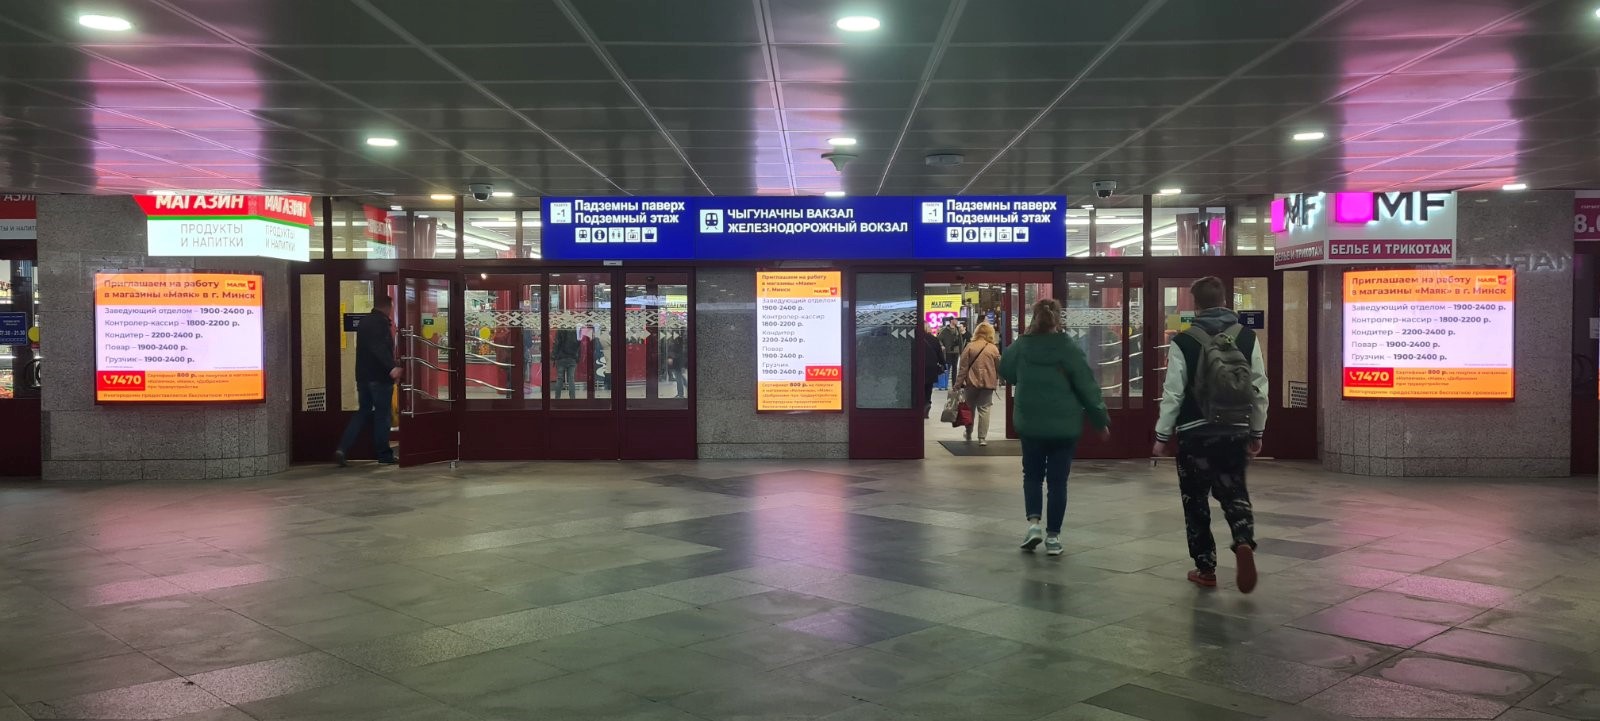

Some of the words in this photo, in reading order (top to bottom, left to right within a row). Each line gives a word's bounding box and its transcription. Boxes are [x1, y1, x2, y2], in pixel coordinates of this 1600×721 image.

[265, 196, 306, 217] МАГАЗИН
[575, 200, 638, 212] Падземны
[642, 202, 685, 212] паверх
[947, 199, 1010, 212] Падземны
[1014, 202, 1057, 212] паверх
[1374, 191, 1451, 221] MF
[557, 209, 566, 217] -1
[728, 209, 803, 219] ЧЫГУНАЧНЫ
[807, 209, 854, 219] ВАКЗАЛ
[929, 208, 937, 217] -1
[575, 212, 647, 225] Подземный
[650, 214, 679, 224] этаж
[947, 212, 1018, 225] Подземный
[1022, 214, 1051, 224] этаж
[181, 224, 243, 235] ПРОДУКТЫ
[728, 221, 856, 233] ЖЕЛЕЗНОДОРОЖНЫЙ
[860, 222, 908, 232] ВОКЗАЛ
[266, 225, 296, 240] ПРОДУКТЫ
[181, 237, 188, 247] И
[193, 237, 244, 247] НАПИТКИ
[271, 239, 296, 252] НАПИТКИ
[1331, 244, 1369, 255] БЕЛЬЕ
[1373, 244, 1381, 254] И
[1385, 244, 1451, 255] ТРИКОТАЖ
[104, 280, 167, 289] Приглашаем
[184, 279, 220, 289] работу
[1352, 277, 1420, 286] Приглашаем
[1436, 277, 1471, 286] работу
[163, 291, 200, 299] «Маяк»
[222, 291, 255, 299] Минск
[1473, 287, 1506, 295] Минск
[104, 307, 157, 315] Заведующий
[247, 308, 254, 316] р.
[1352, 304, 1408, 312] Заведующий
[232, 320, 240, 328] р.
[1352, 316, 1432, 324] Контролер-кассир
[195, 332, 203, 340] р.
[180, 344, 188, 352] р.
[105, 356, 137, 364] Грузчик
[187, 356, 195, 364] р.
[1352, 353, 1385, 361] Грузчик
[813, 369, 839, 377] 7470
[1357, 371, 1390, 382] 7470
[111, 375, 142, 385] 7470
